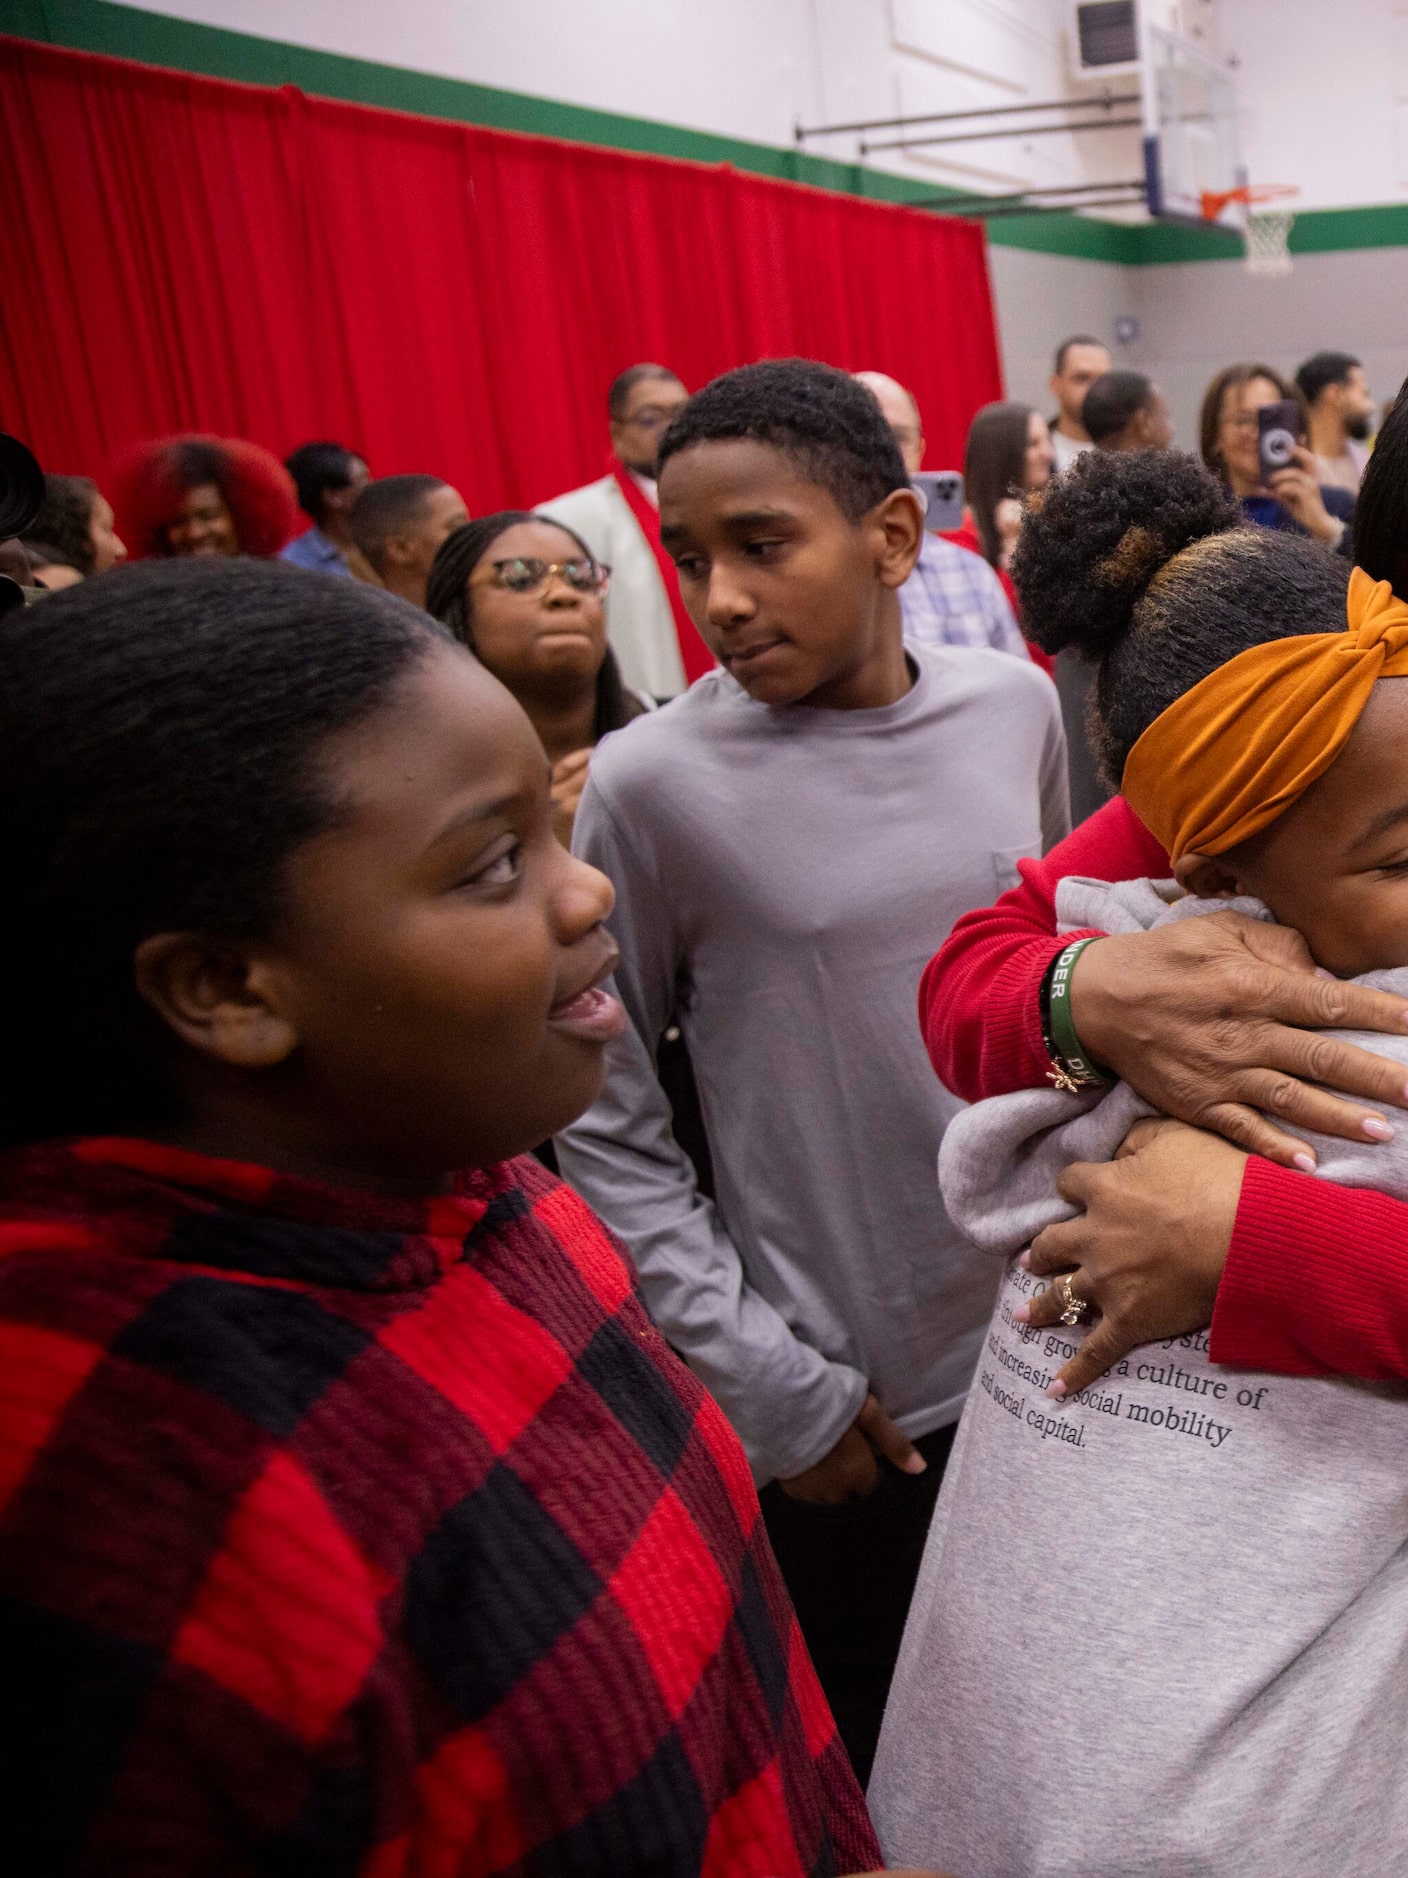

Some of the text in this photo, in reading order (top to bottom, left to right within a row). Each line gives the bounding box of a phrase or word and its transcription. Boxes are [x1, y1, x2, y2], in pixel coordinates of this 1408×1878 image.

[1117, 1359, 1129, 1377] a
[1136, 1363, 1228, 1400] culture
[1236, 1387, 1269, 1410] of
[993, 1385, 1025, 1420] social
[1026, 1409, 1086, 1448] capital.
[1073, 1389, 1122, 1416] social
[1126, 1403, 1233, 1448] mobility
